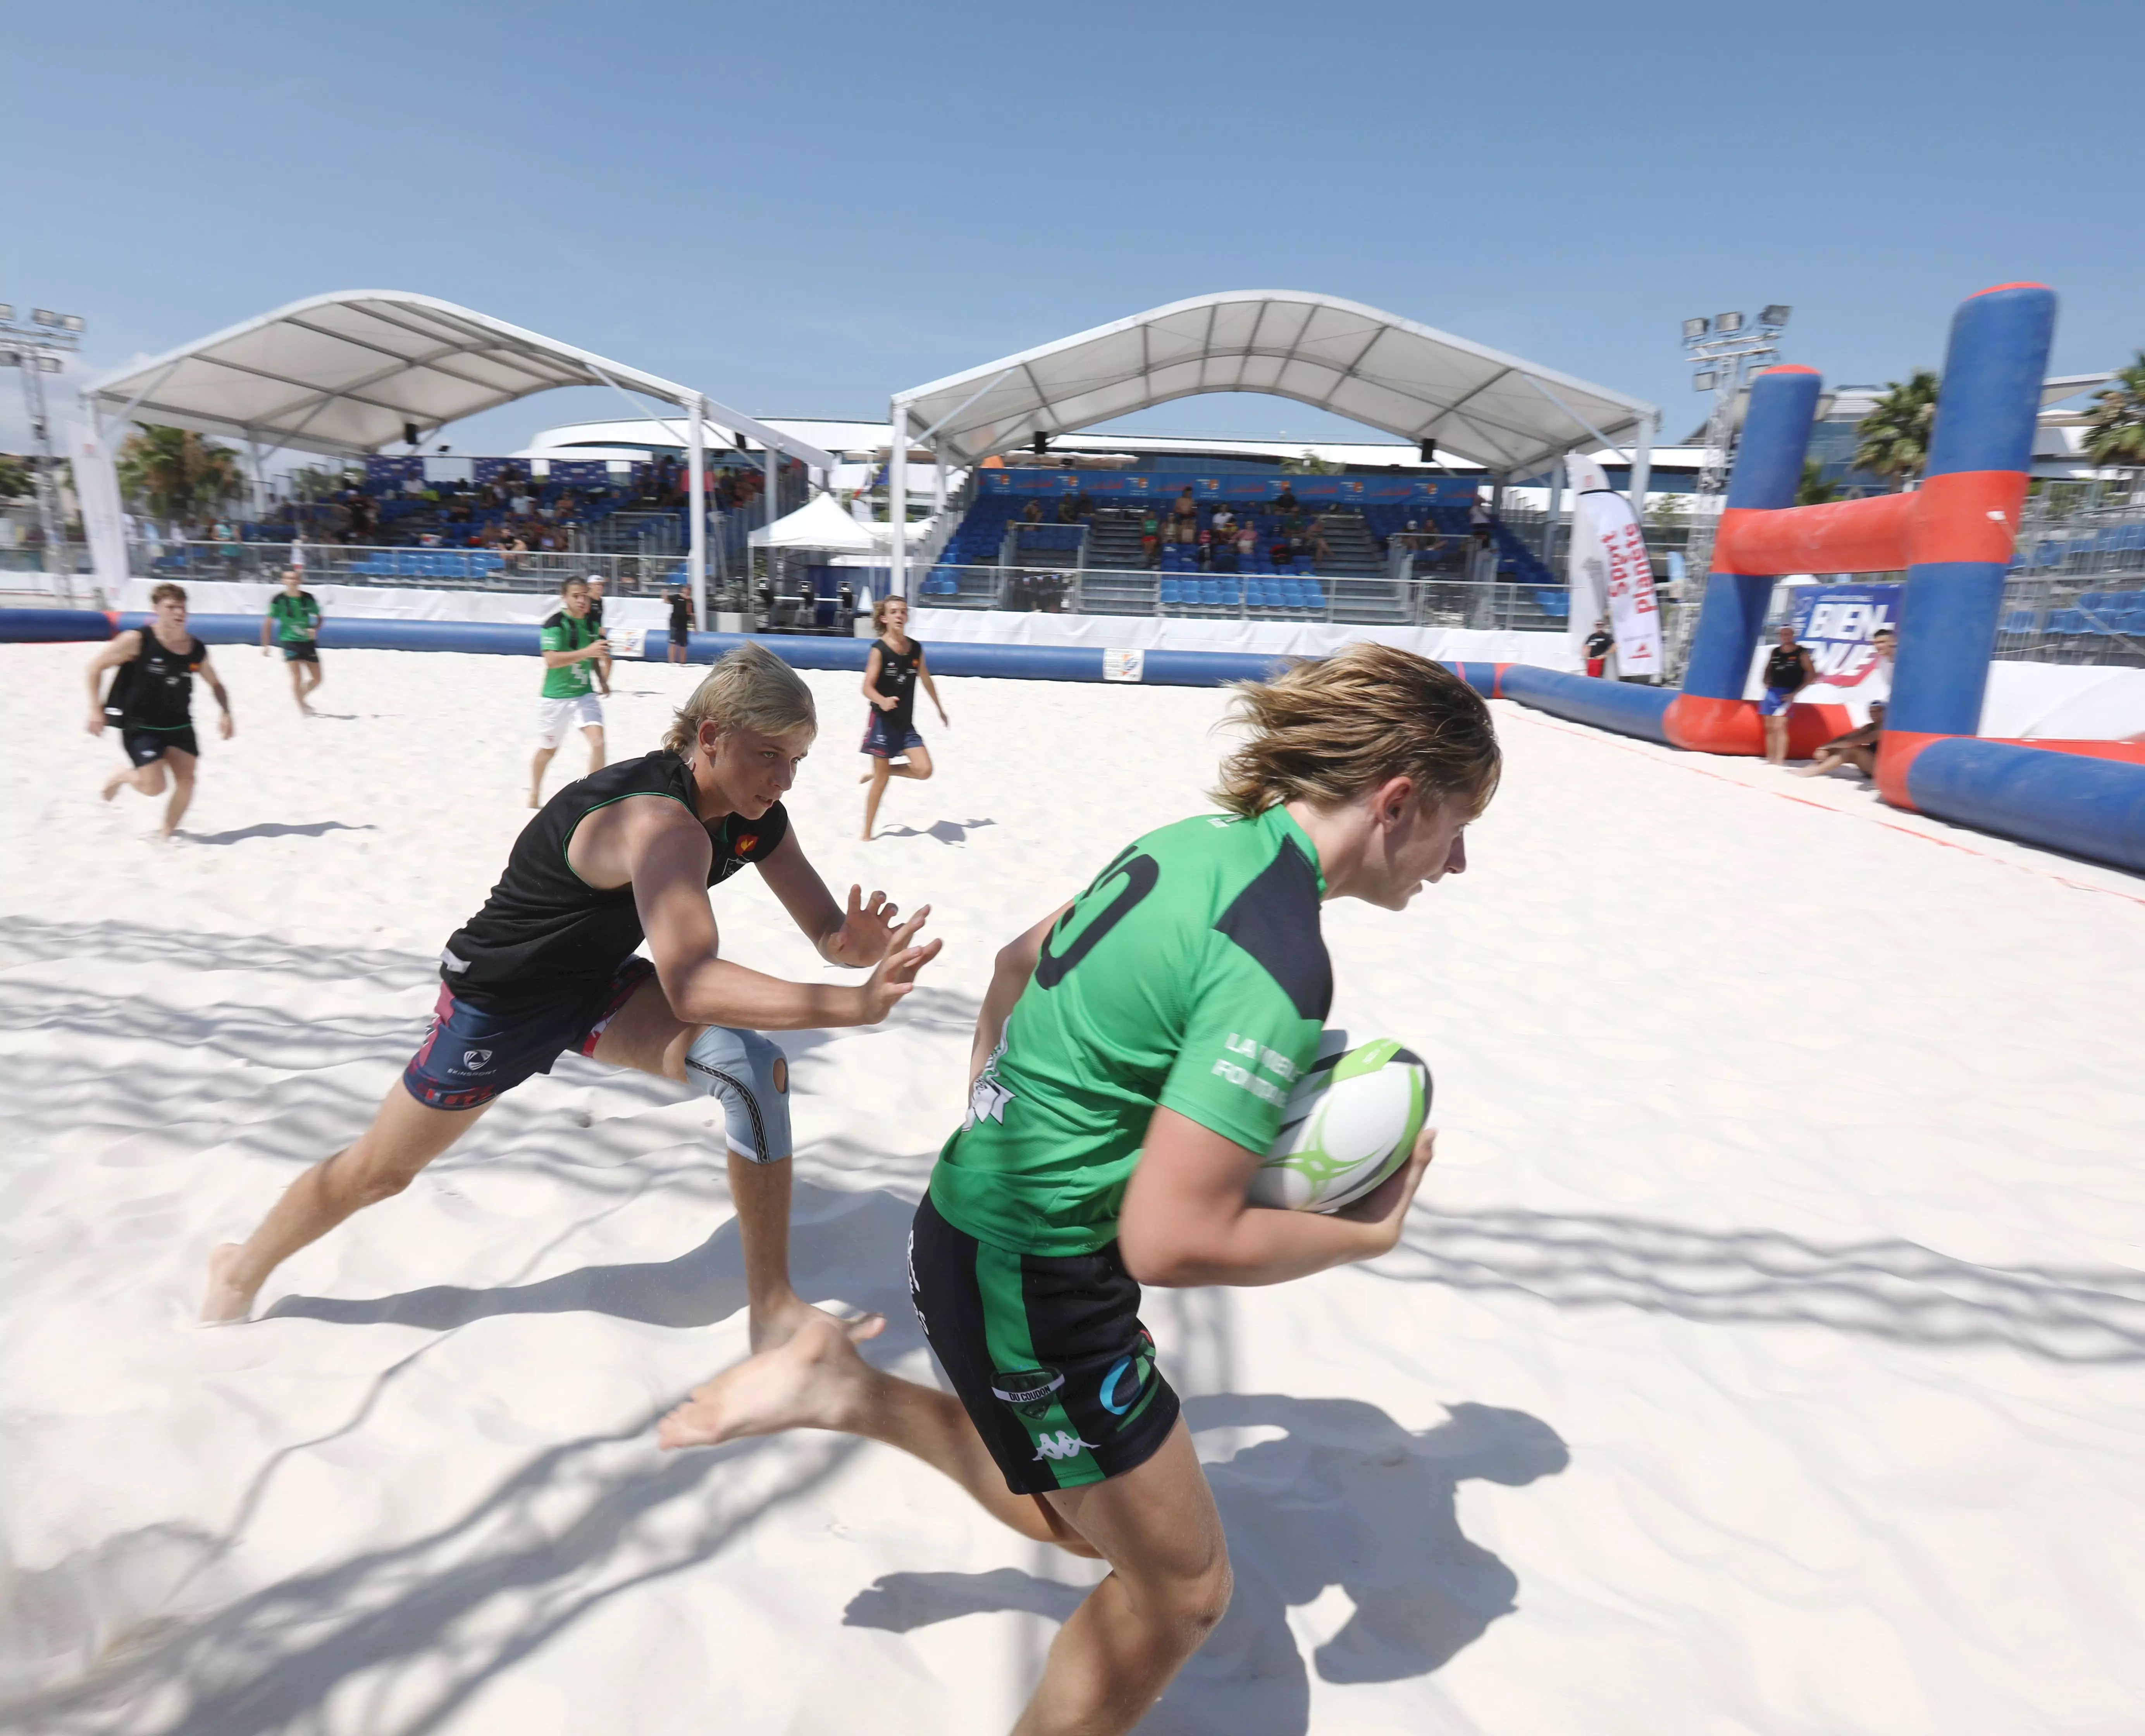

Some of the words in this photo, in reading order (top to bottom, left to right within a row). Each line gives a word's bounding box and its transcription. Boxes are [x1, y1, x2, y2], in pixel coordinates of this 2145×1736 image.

[1601, 530, 1628, 597] Sport
[1224, 1032, 1257, 1059] LA
[1009, 1393, 1020, 1402] DU
[1021, 1385, 1051, 1401] COUDON
